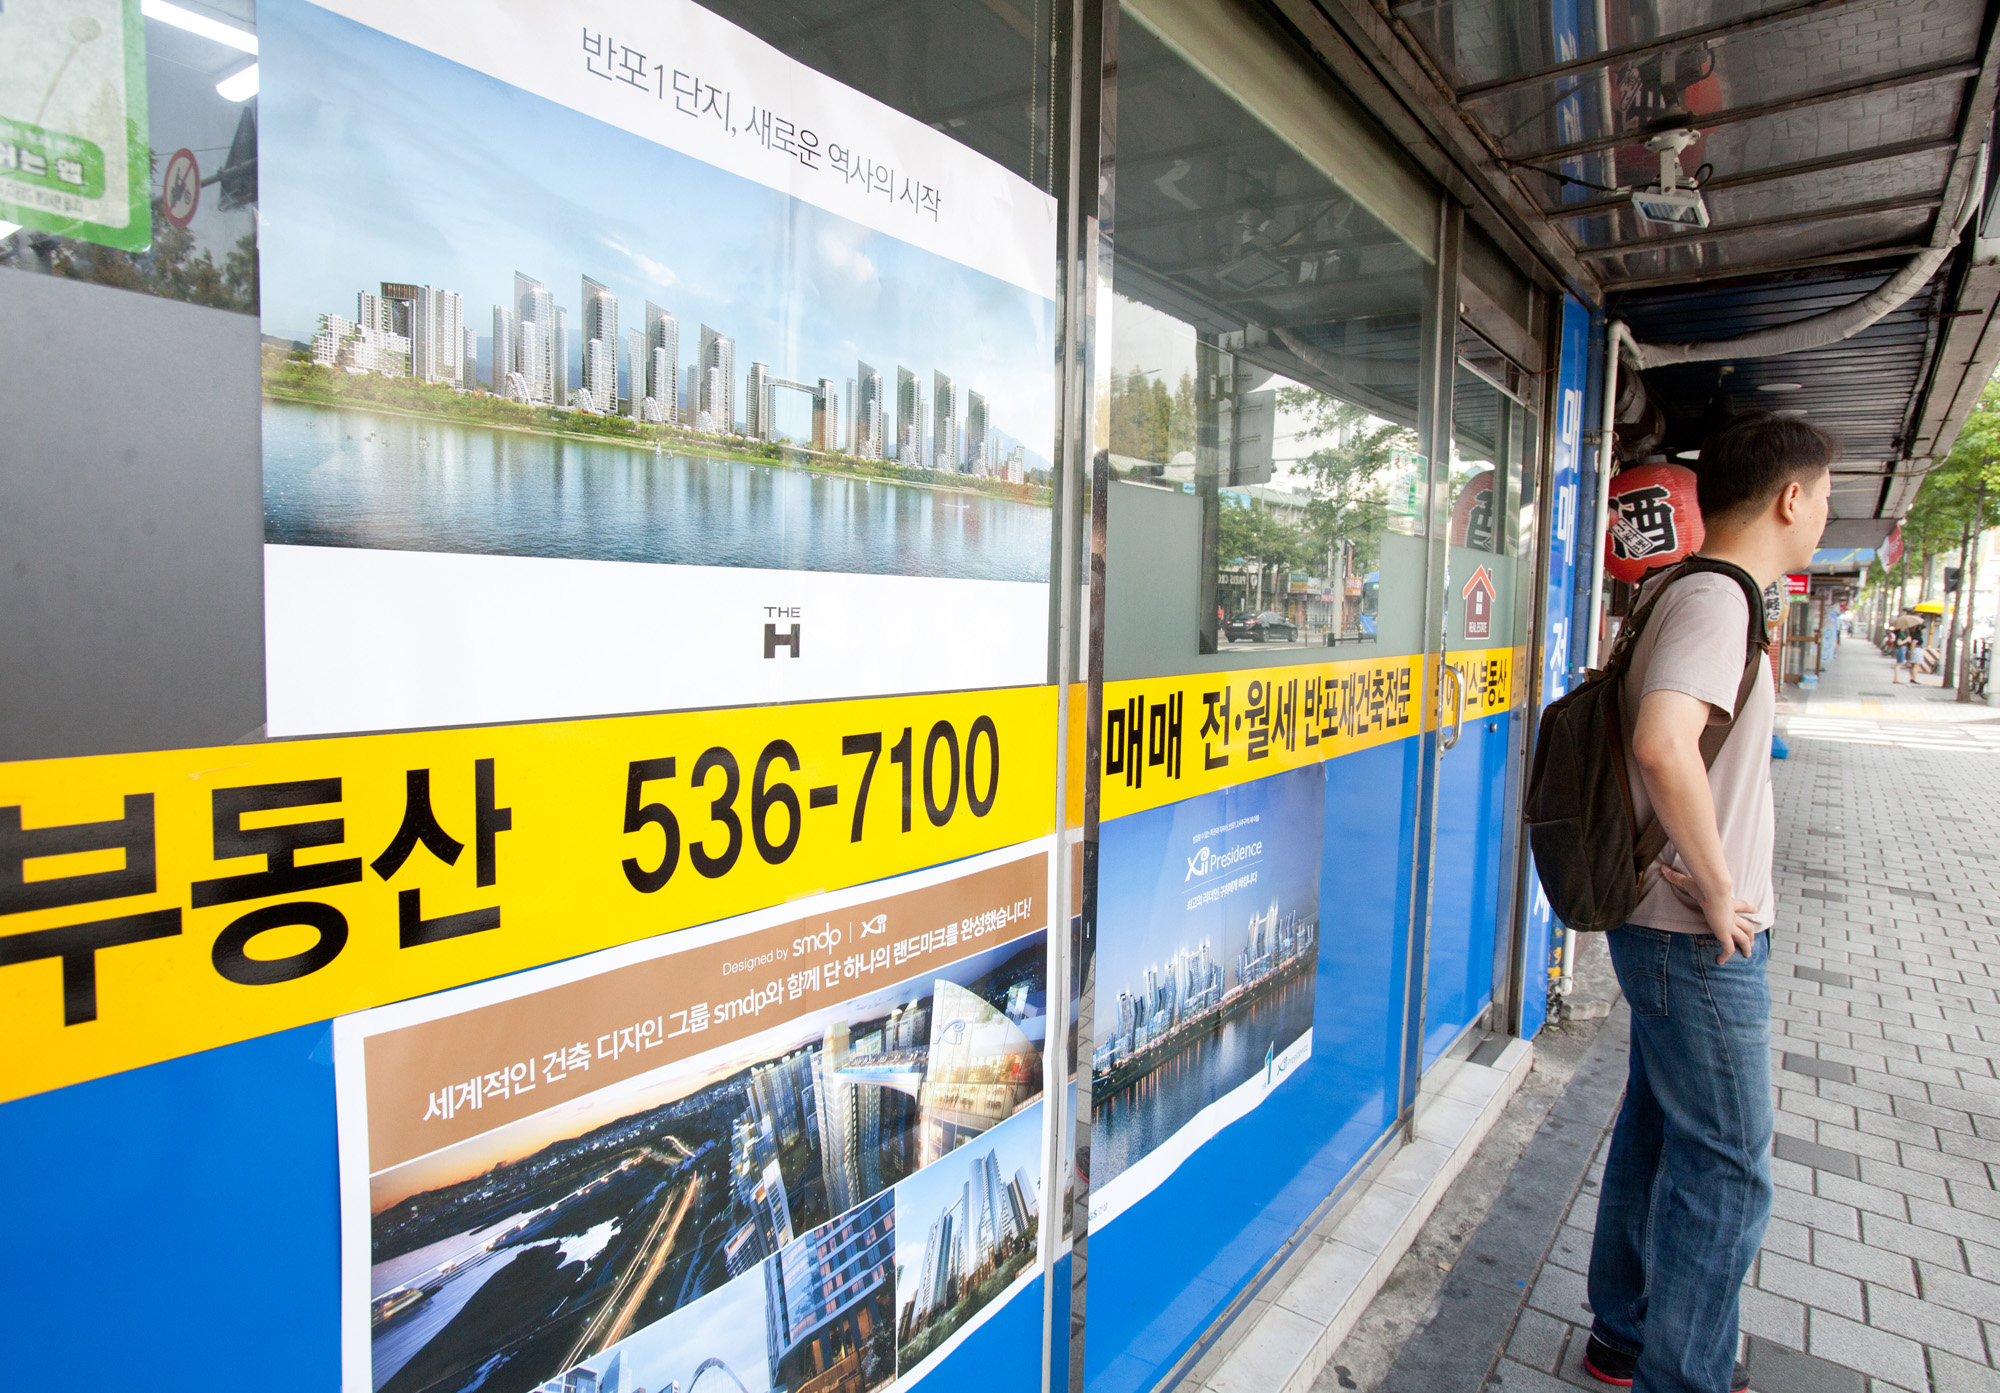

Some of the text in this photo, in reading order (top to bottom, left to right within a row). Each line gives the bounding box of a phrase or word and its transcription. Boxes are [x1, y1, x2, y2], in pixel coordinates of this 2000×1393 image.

[582, 27, 943, 223] 반포1단지, 새로운 역사의 시작
[0, 140, 47, 178] 는
[1607, 484, 1678, 560] 酒
[764, 606, 800, 618] THE
[764, 623, 800, 659] H
[1105, 690, 1184, 790] 매매
[1304, 666, 1411, 748] 반포재건축전문
[0, 714, 1000, 1028] 부동산 536-7100
[1210, 841, 1263, 873] Presidence
[722, 950, 774, 977] Designed
[776, 945, 789, 962] by
[792, 921, 842, 958] smdp
[422, 896, 1032, 1121] 세계적인 건축 디자인 그룹 smdp와 함께 단 하나의 랜드마크를 완성했습니다!
